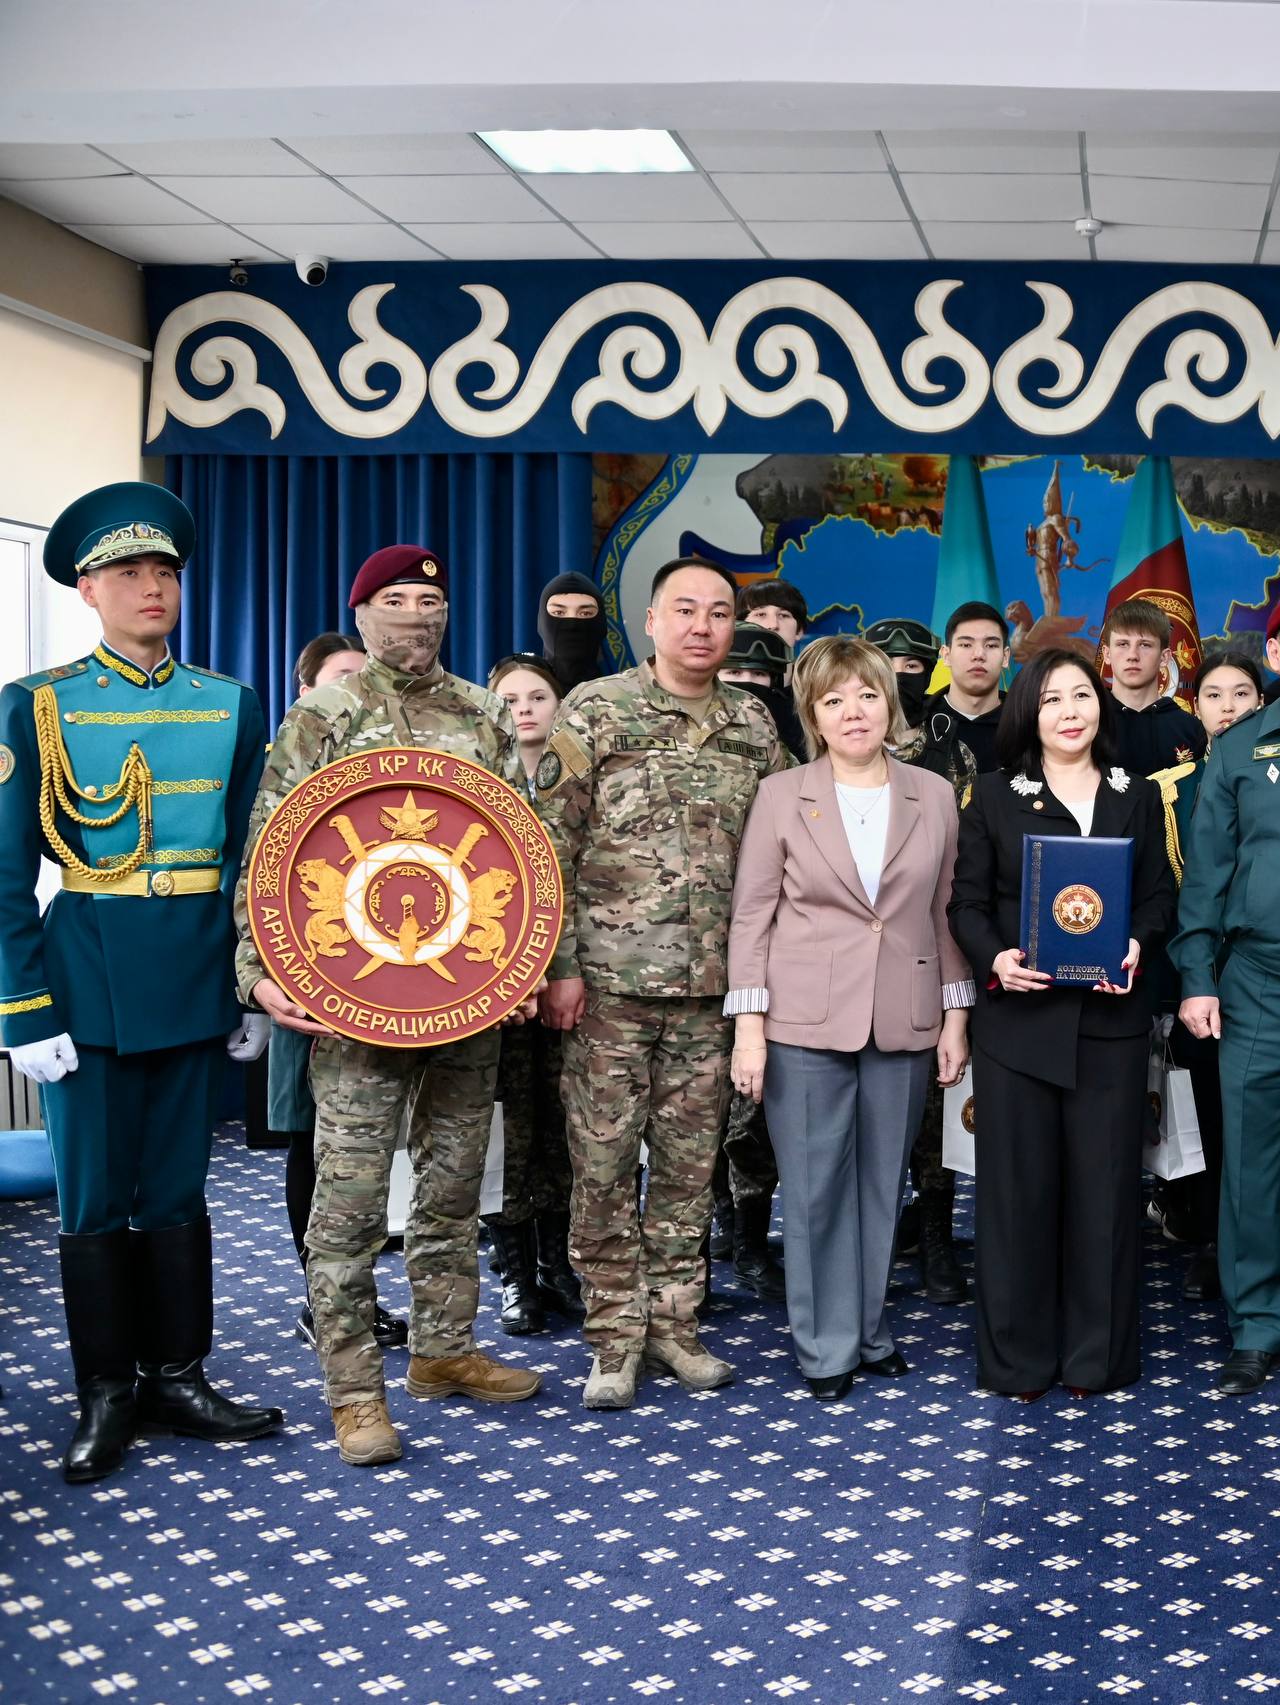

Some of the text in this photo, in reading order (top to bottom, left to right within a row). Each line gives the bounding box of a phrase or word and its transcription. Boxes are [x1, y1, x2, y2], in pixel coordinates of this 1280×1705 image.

[378, 755, 447, 778] ҚР ҚК
[260, 906, 553, 1038] АРНАЙЫ ОПЕРАЦИЯЛАР КҮШТЕРІ
